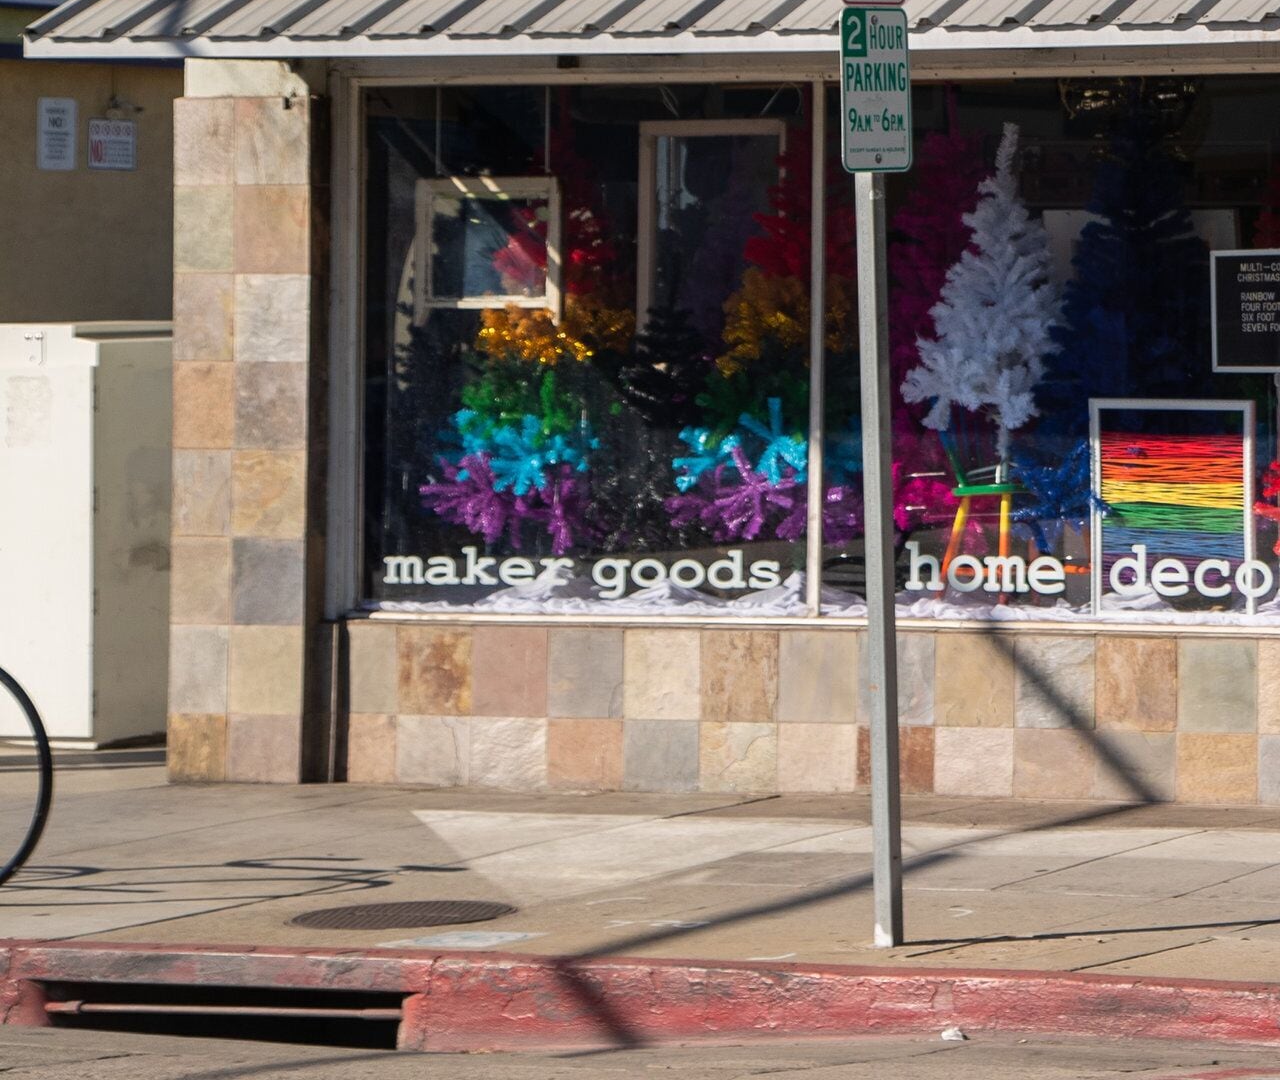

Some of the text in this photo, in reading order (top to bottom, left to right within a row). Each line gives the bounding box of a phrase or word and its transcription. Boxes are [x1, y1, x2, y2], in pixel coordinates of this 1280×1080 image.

[846, 16, 903, 50] 2 HOUR
[846, 63, 906, 92] PARKING
[1237, 273, 1280, 282] CHRISTMAS
[1240, 292, 1275, 300] RAINBOW
[1241, 302, 1261, 311] FOUR
[1262, 302, 1280, 310] FOOT
[1241, 313, 1253, 321] SIX
[1257, 313, 1275, 321] FOOT
[1242, 323, 1267, 332] SEVEN
[904, 541, 1066, 594] home
[382, 546, 781, 600] maker goods
